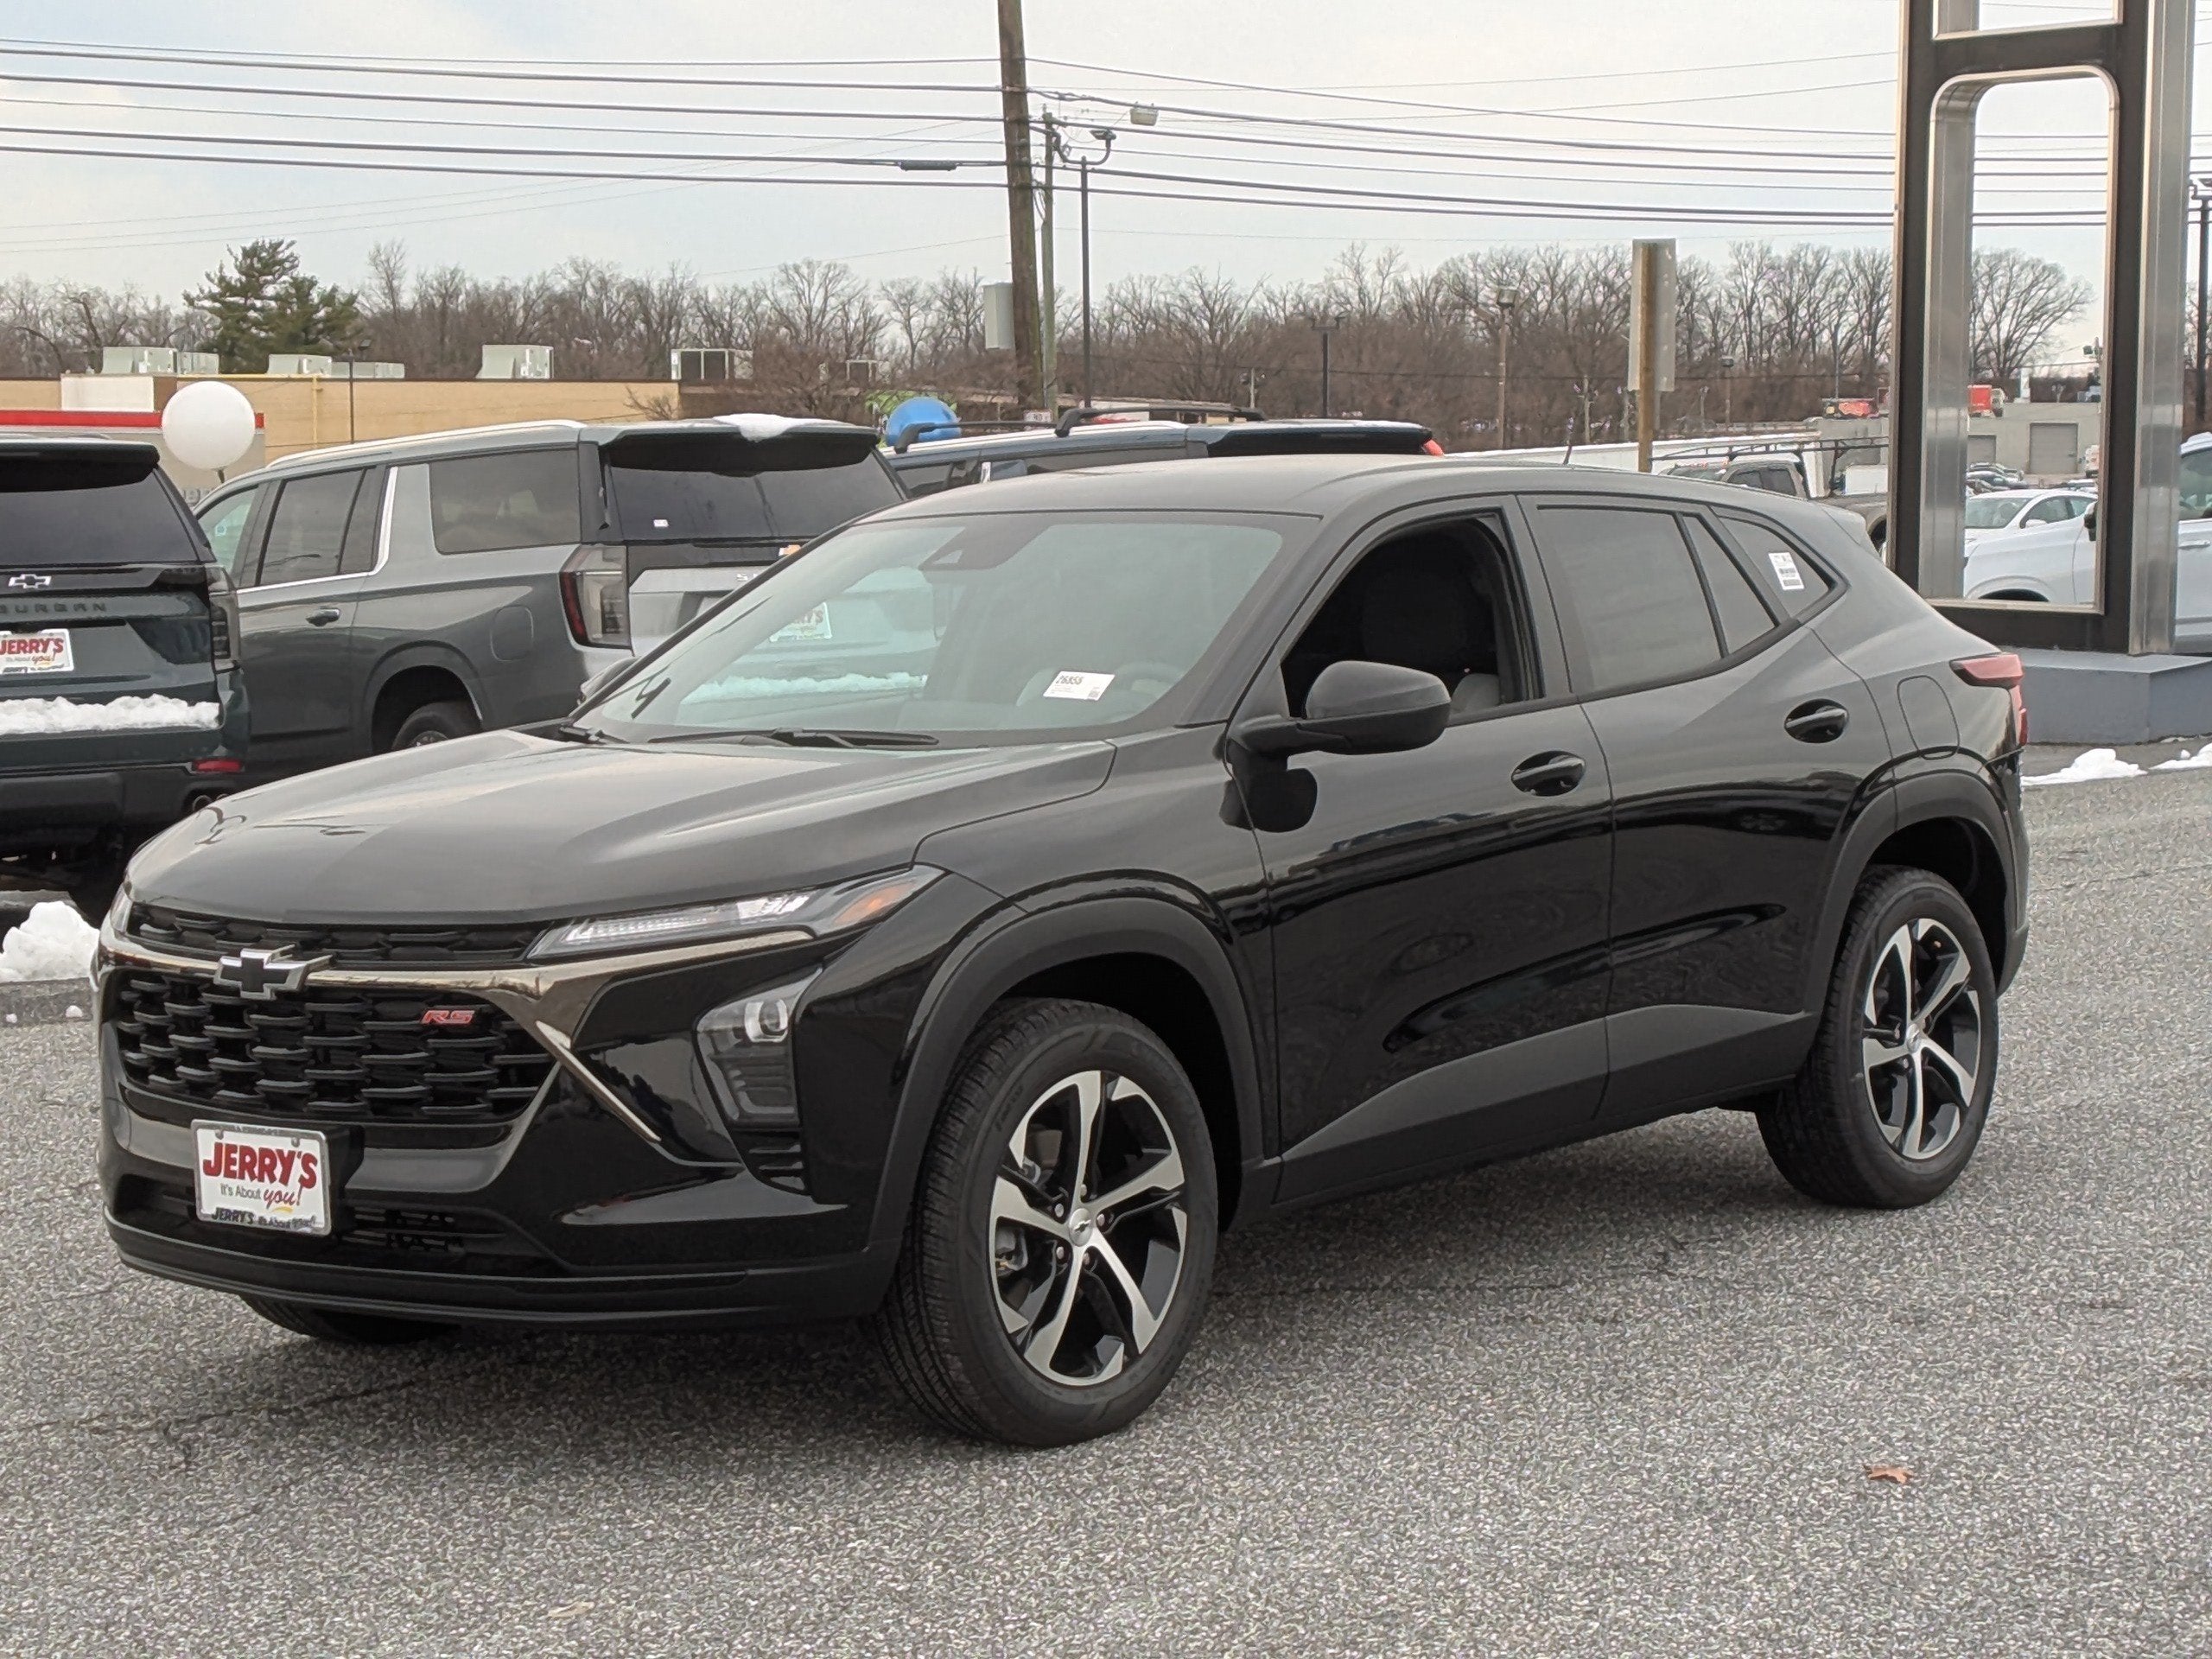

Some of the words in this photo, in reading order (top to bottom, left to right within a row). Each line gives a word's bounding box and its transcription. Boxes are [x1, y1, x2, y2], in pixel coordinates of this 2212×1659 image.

[421, 1009, 474, 1025] RS
[203, 1141, 318, 1189] JERRY'S
[220, 1183, 233, 1196] It's
[235, 1185, 262, 1199] About
